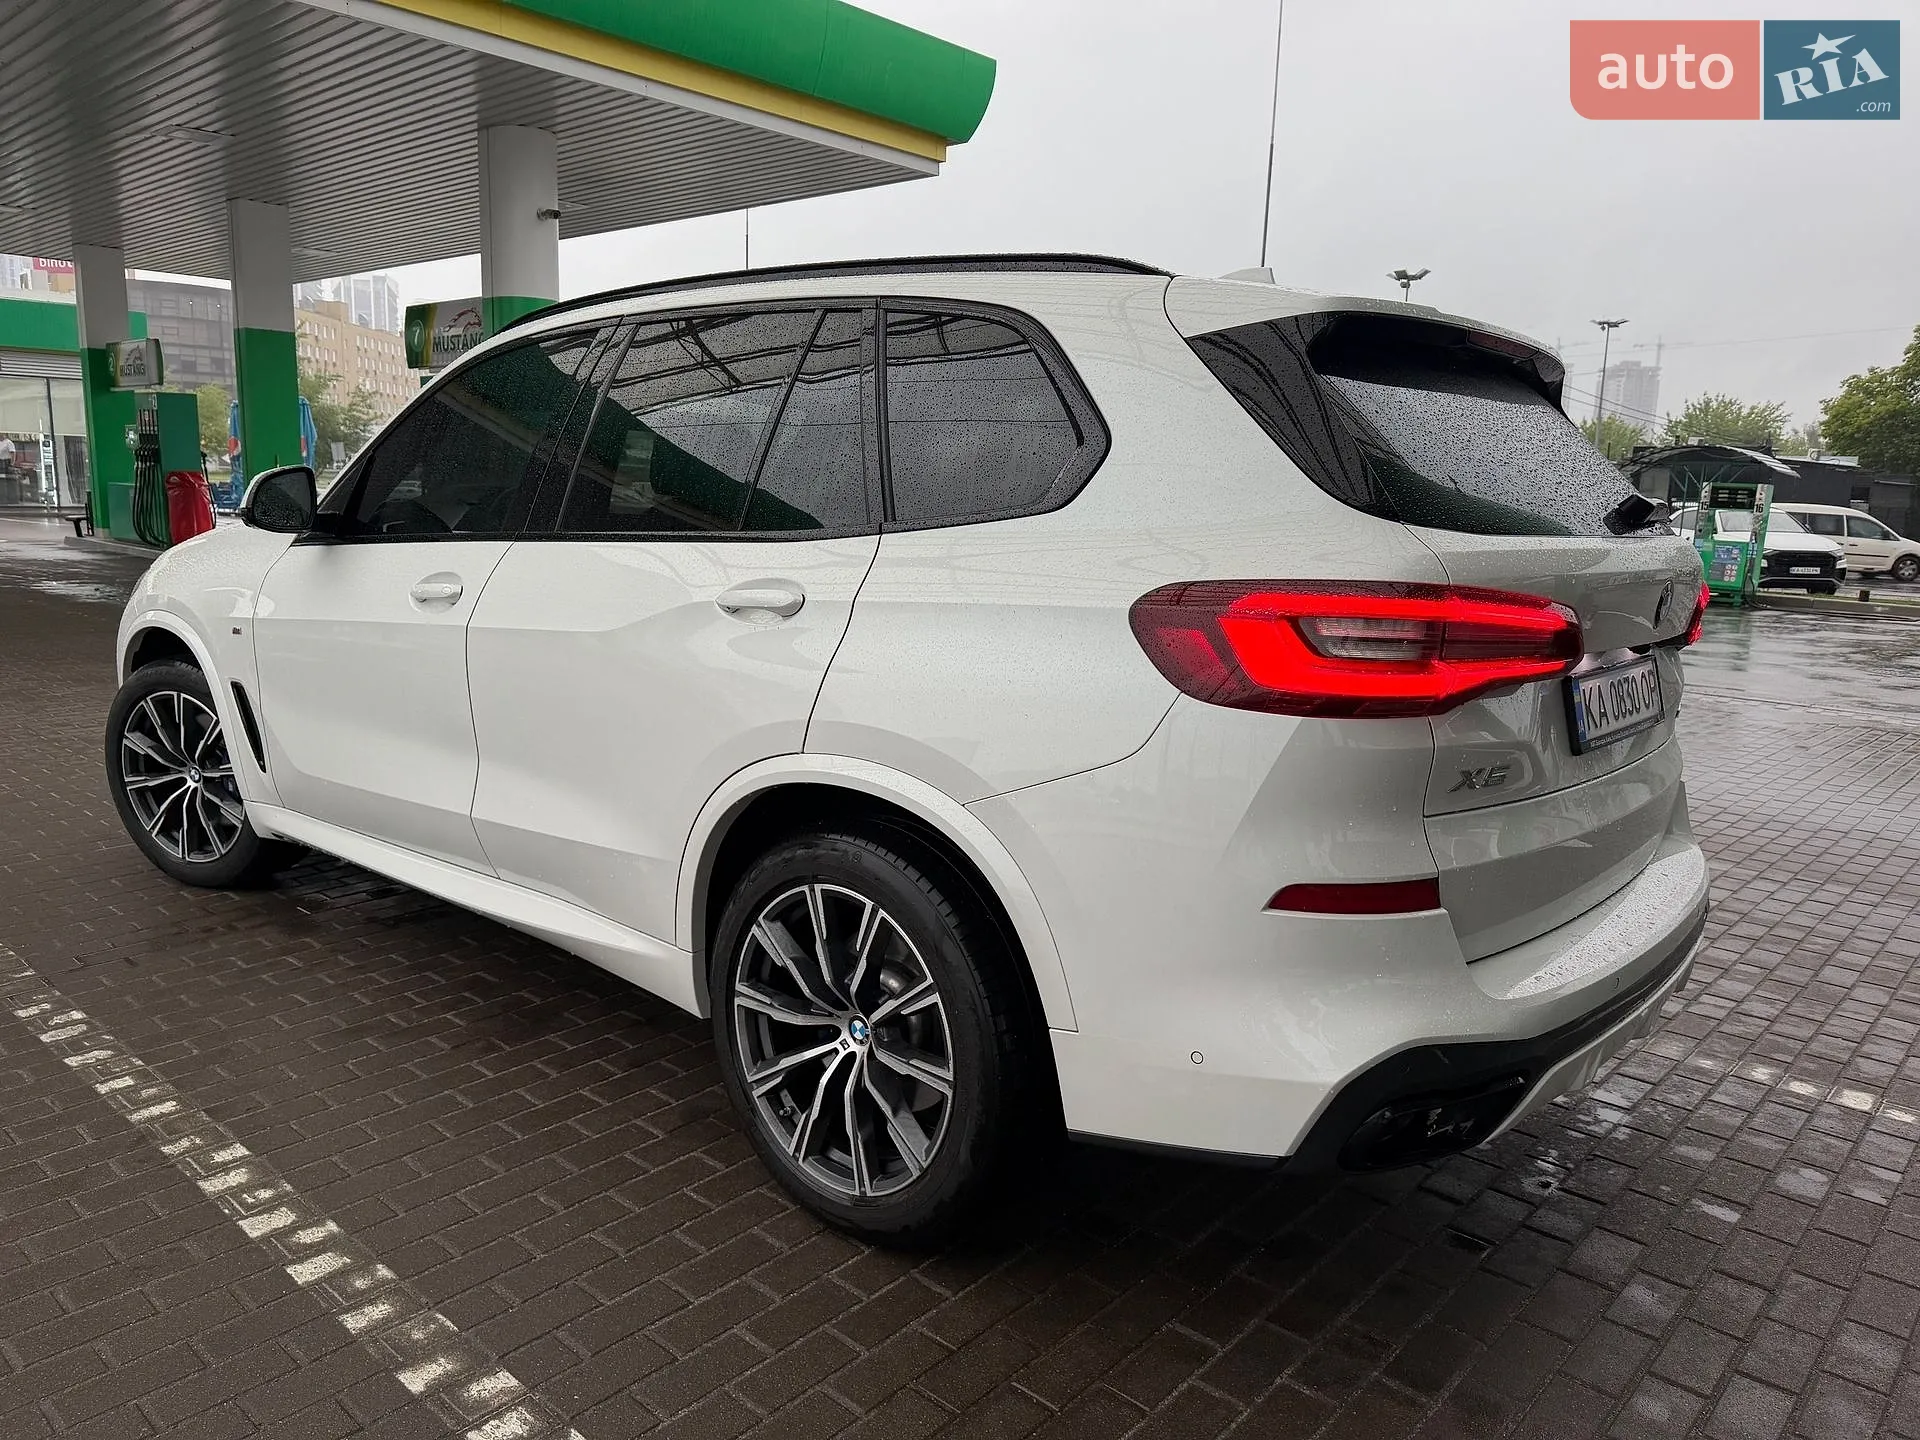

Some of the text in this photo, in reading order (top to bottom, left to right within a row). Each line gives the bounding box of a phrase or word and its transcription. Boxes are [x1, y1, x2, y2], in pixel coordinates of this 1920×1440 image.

[412, 326, 420, 346] 7
[1700, 501, 1710, 511] 15
[1755, 502, 1765, 513] 16
[1582, 682, 1611, 731] KA
[1609, 673, 1641, 721] 0830
